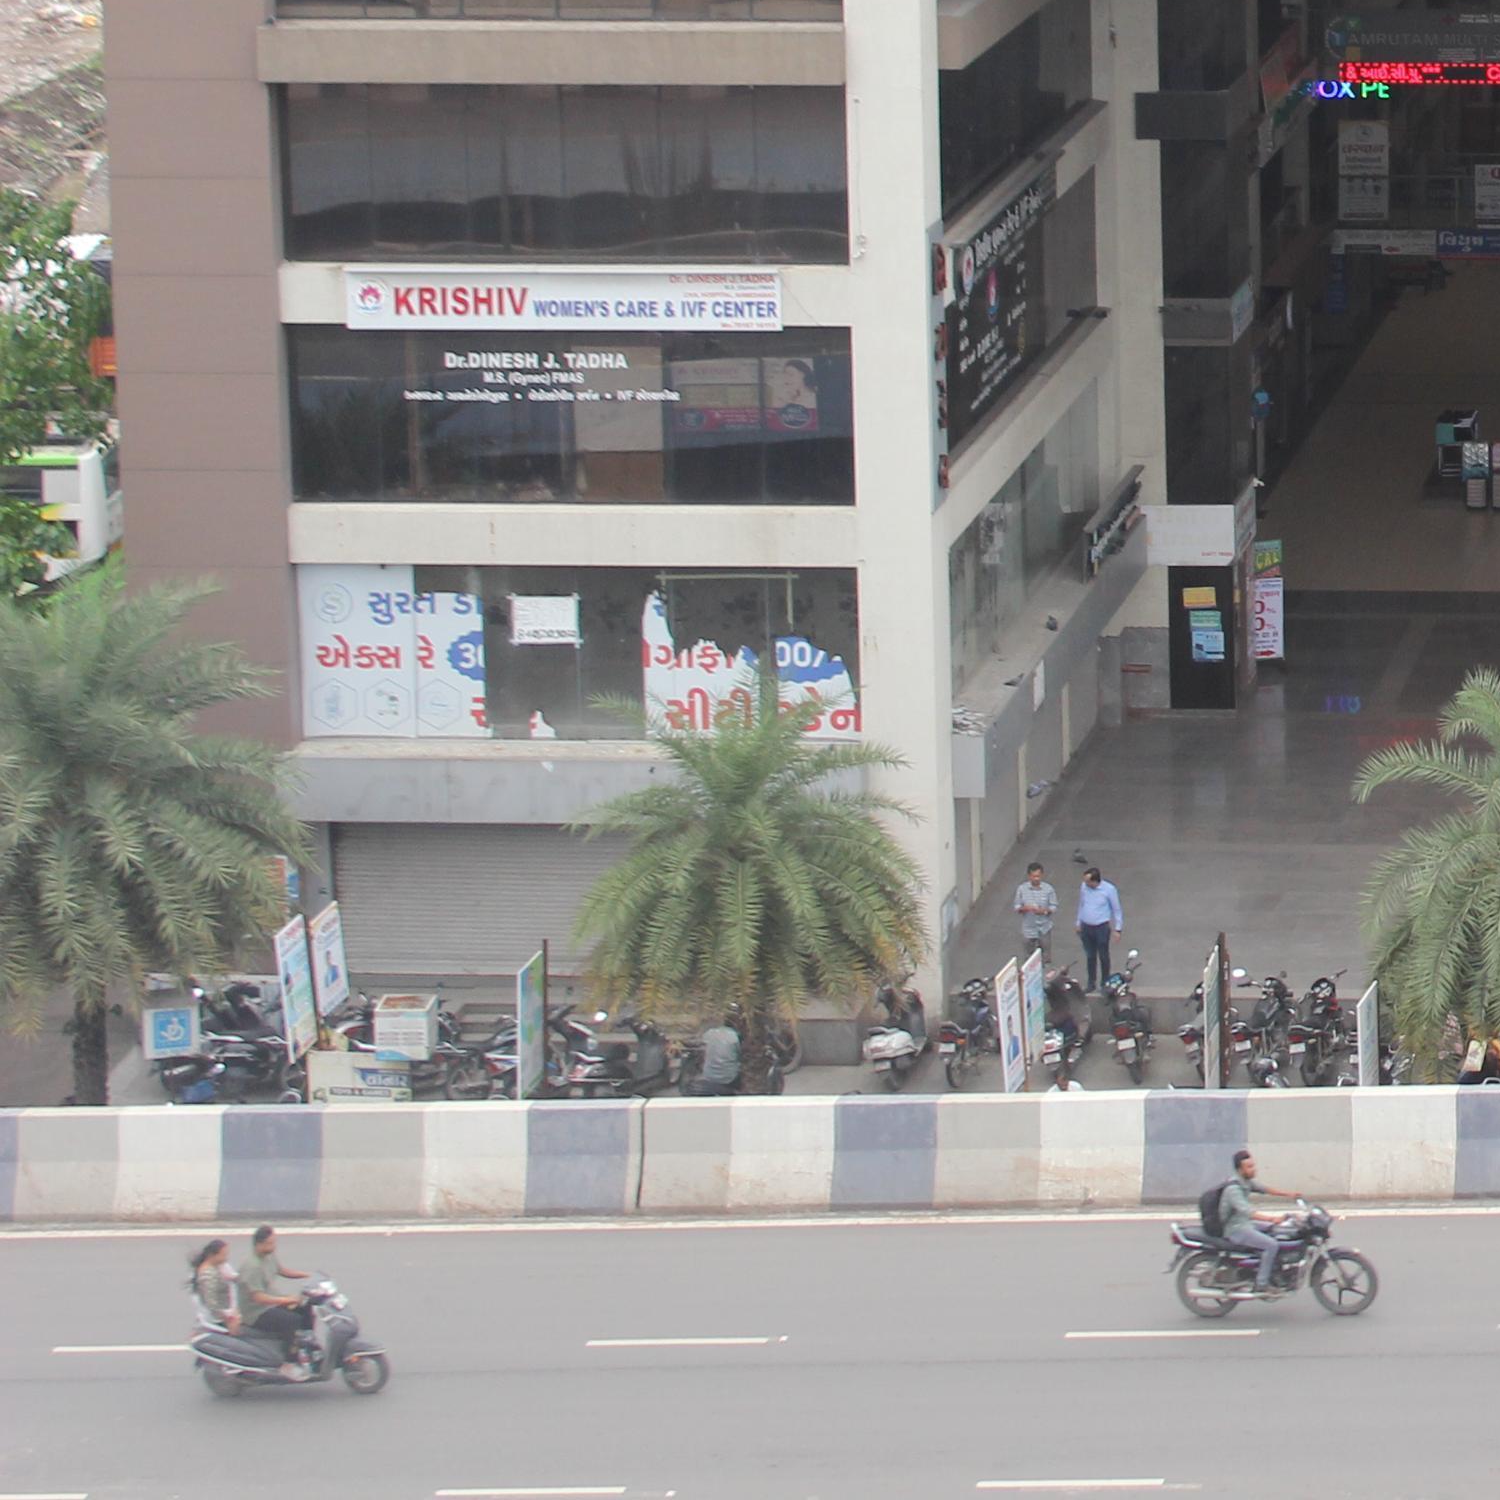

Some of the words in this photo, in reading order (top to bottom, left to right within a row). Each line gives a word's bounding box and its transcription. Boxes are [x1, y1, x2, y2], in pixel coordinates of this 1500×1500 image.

[393, 287, 528, 317] KRISHIV
[534, 300, 610, 319] WOMEN'S
[615, 300, 658, 318] CARE
[664, 301, 675, 318] &
[681, 300, 707, 318] IVF
[712, 300, 777, 319] CENTER
[564, 353, 628, 369] TADHA
